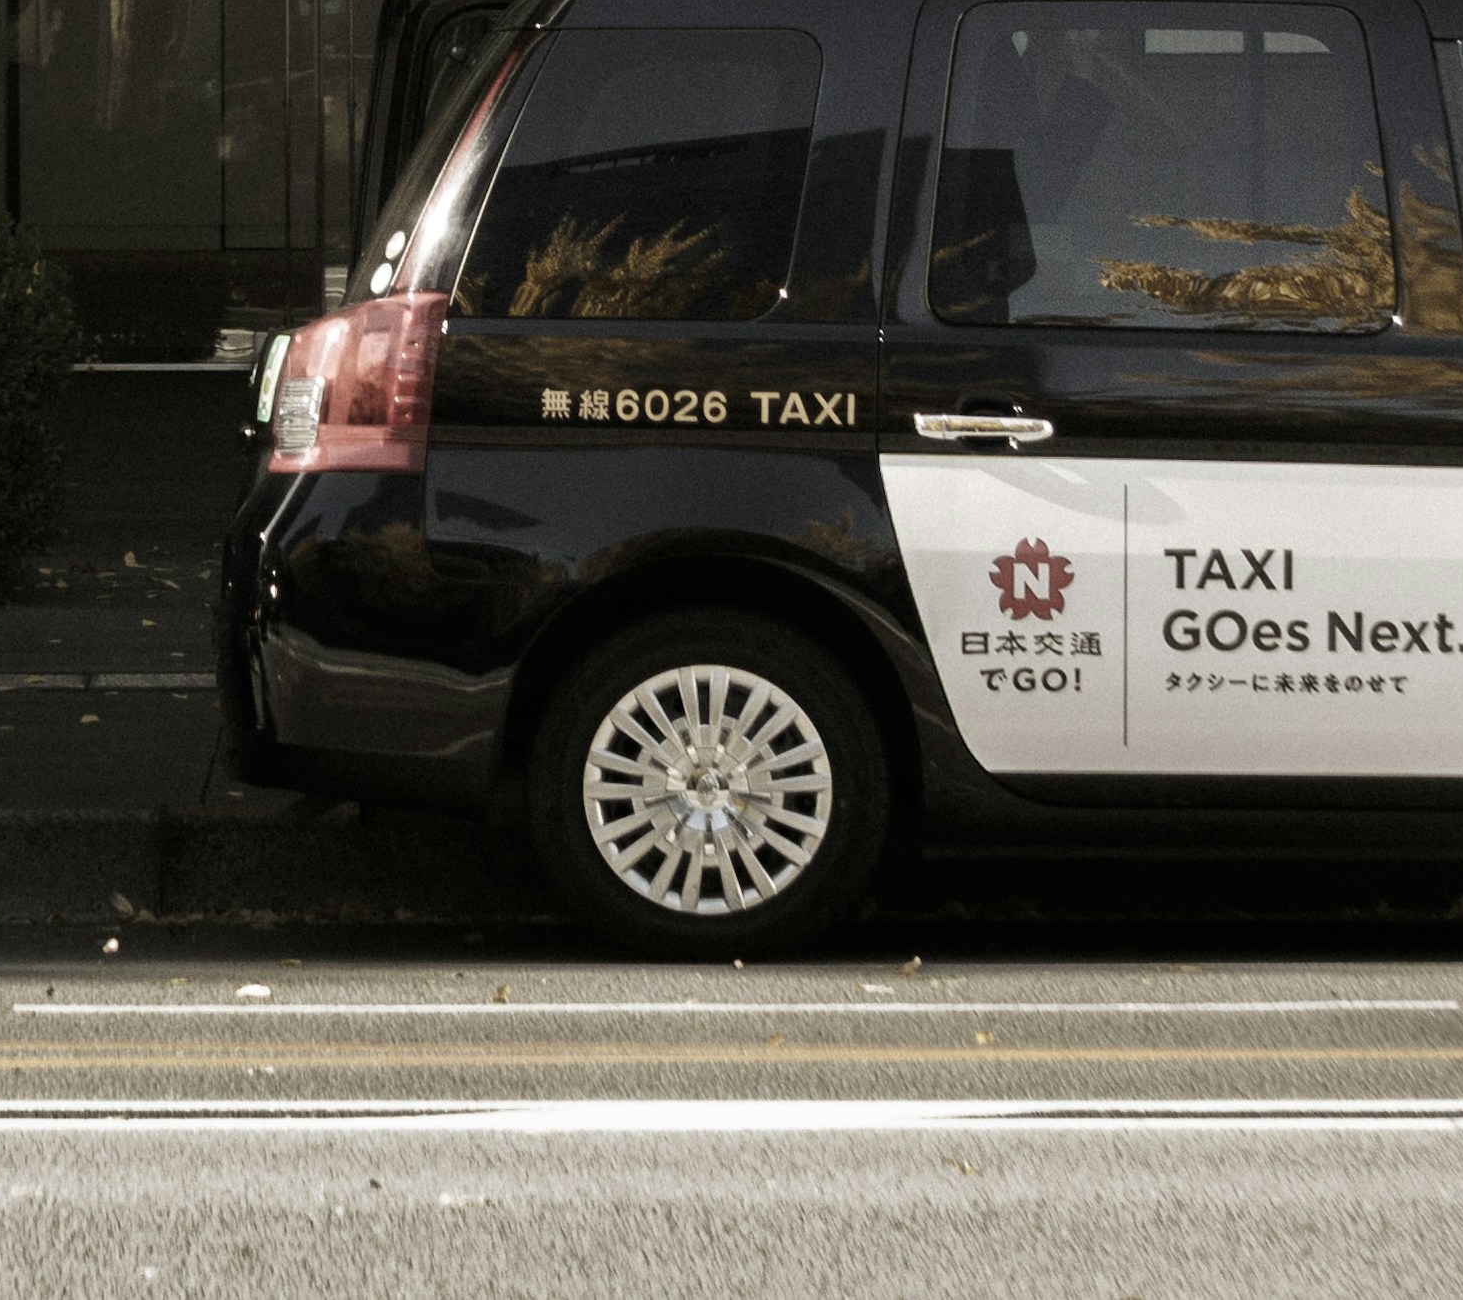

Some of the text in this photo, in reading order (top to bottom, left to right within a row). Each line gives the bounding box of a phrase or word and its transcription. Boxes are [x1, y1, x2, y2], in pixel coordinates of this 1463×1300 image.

[750, 391, 855, 426] TAXI
[1164, 548, 1294, 591] TAXI
[960, 631, 1103, 657] 日本交通
[1162, 609, 1310, 653] GOes
[980, 667, 1082, 692] でGO!
[1165, 671, 1409, 694] タクシーに未来をのせて
